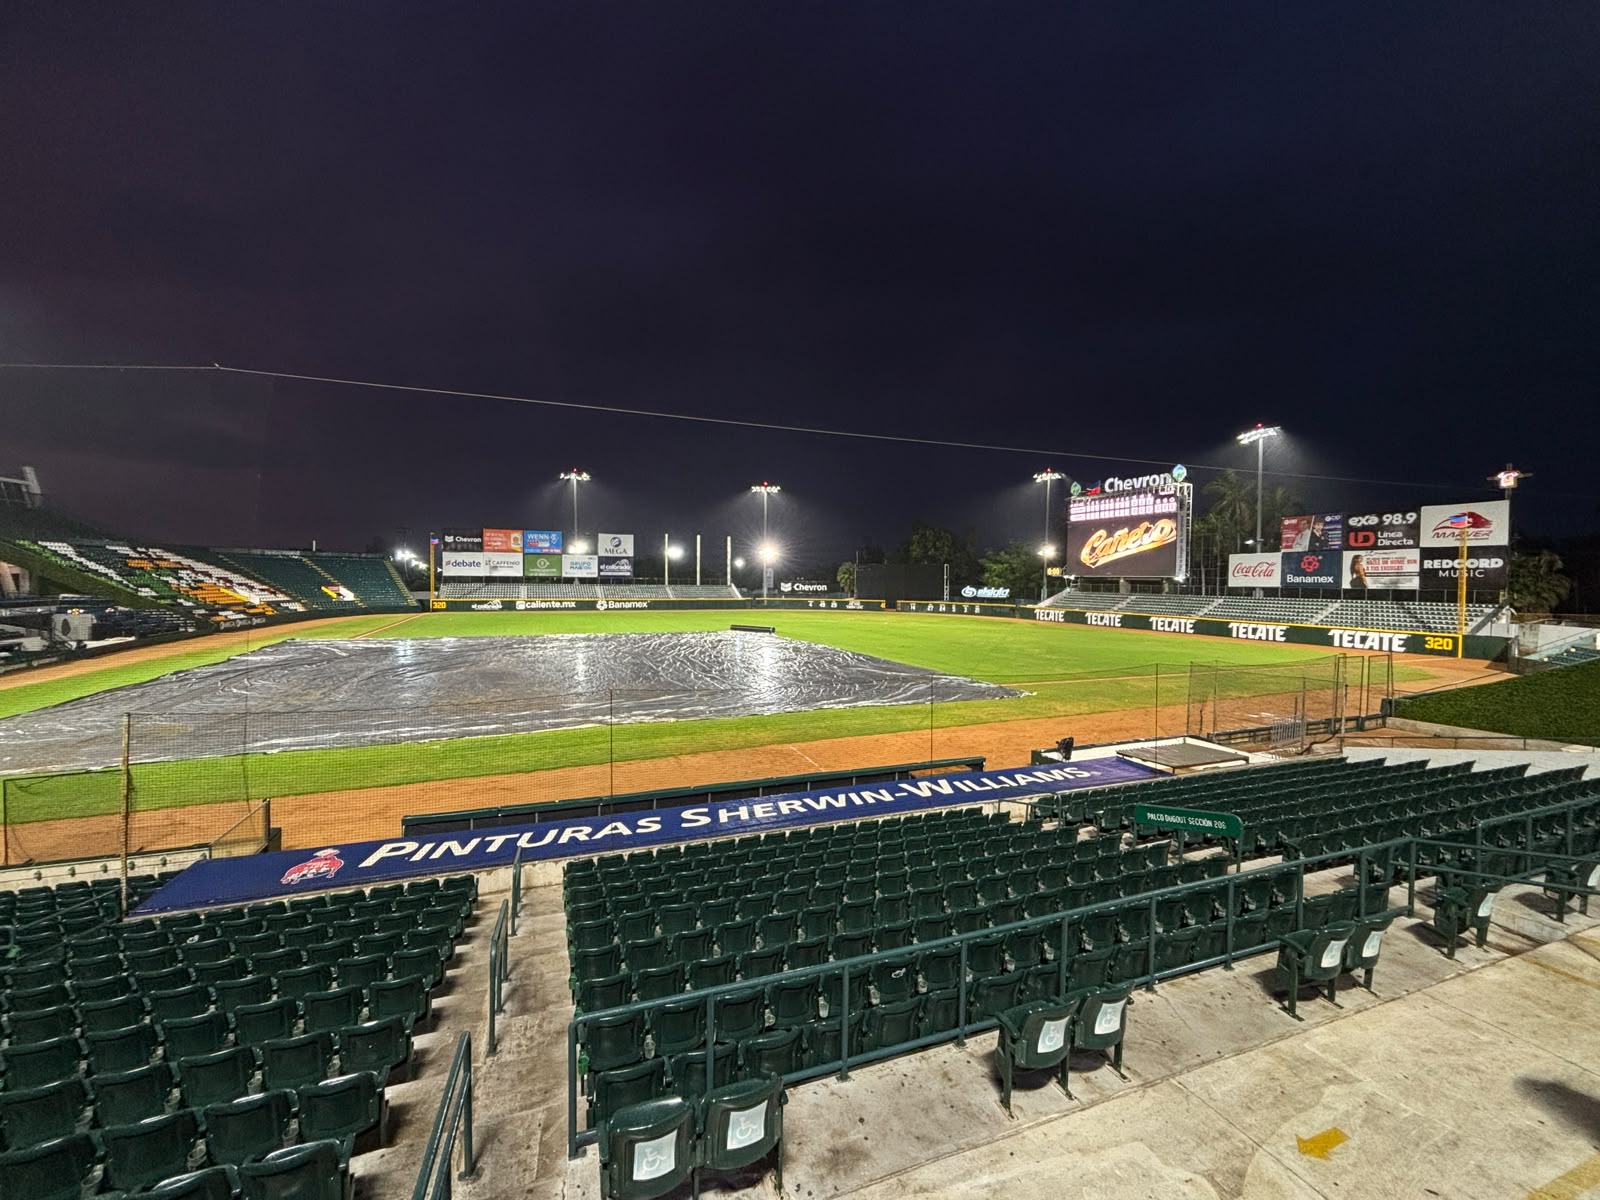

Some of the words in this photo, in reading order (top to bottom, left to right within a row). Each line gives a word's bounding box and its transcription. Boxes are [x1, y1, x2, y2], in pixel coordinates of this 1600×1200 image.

[1104, 473, 1172, 493] Chevron
[1383, 513, 1417, 525] 98.9
[1080, 518, 1177, 568] Cañero
[1378, 538, 1413, 546] Directa
[451, 560, 481, 568] debate
[1423, 558, 1504, 569] REDCORD
[1286, 575, 1333, 583] Banamex
[793, 583, 828, 591] Chevron
[432, 601, 447, 609] 320
[525, 600, 576, 609] caliente.mx
[608, 601, 648, 609] Banamex
[1034, 609, 1066, 622] TECATE
[1085, 612, 1122, 627] TECATE
[1149, 616, 1196, 634] TECATE
[1228, 622, 1289, 642] TECATE
[1328, 630, 1411, 653] TECATE
[1424, 637, 1453, 651] 320
[358, 815, 664, 868] PINTURAS
[681, 765, 1092, 828] SHERWIN-WILLIAMS
[1146, 813, 1164, 821] PALCO
[1165, 815, 1187, 824] DUGOUT
